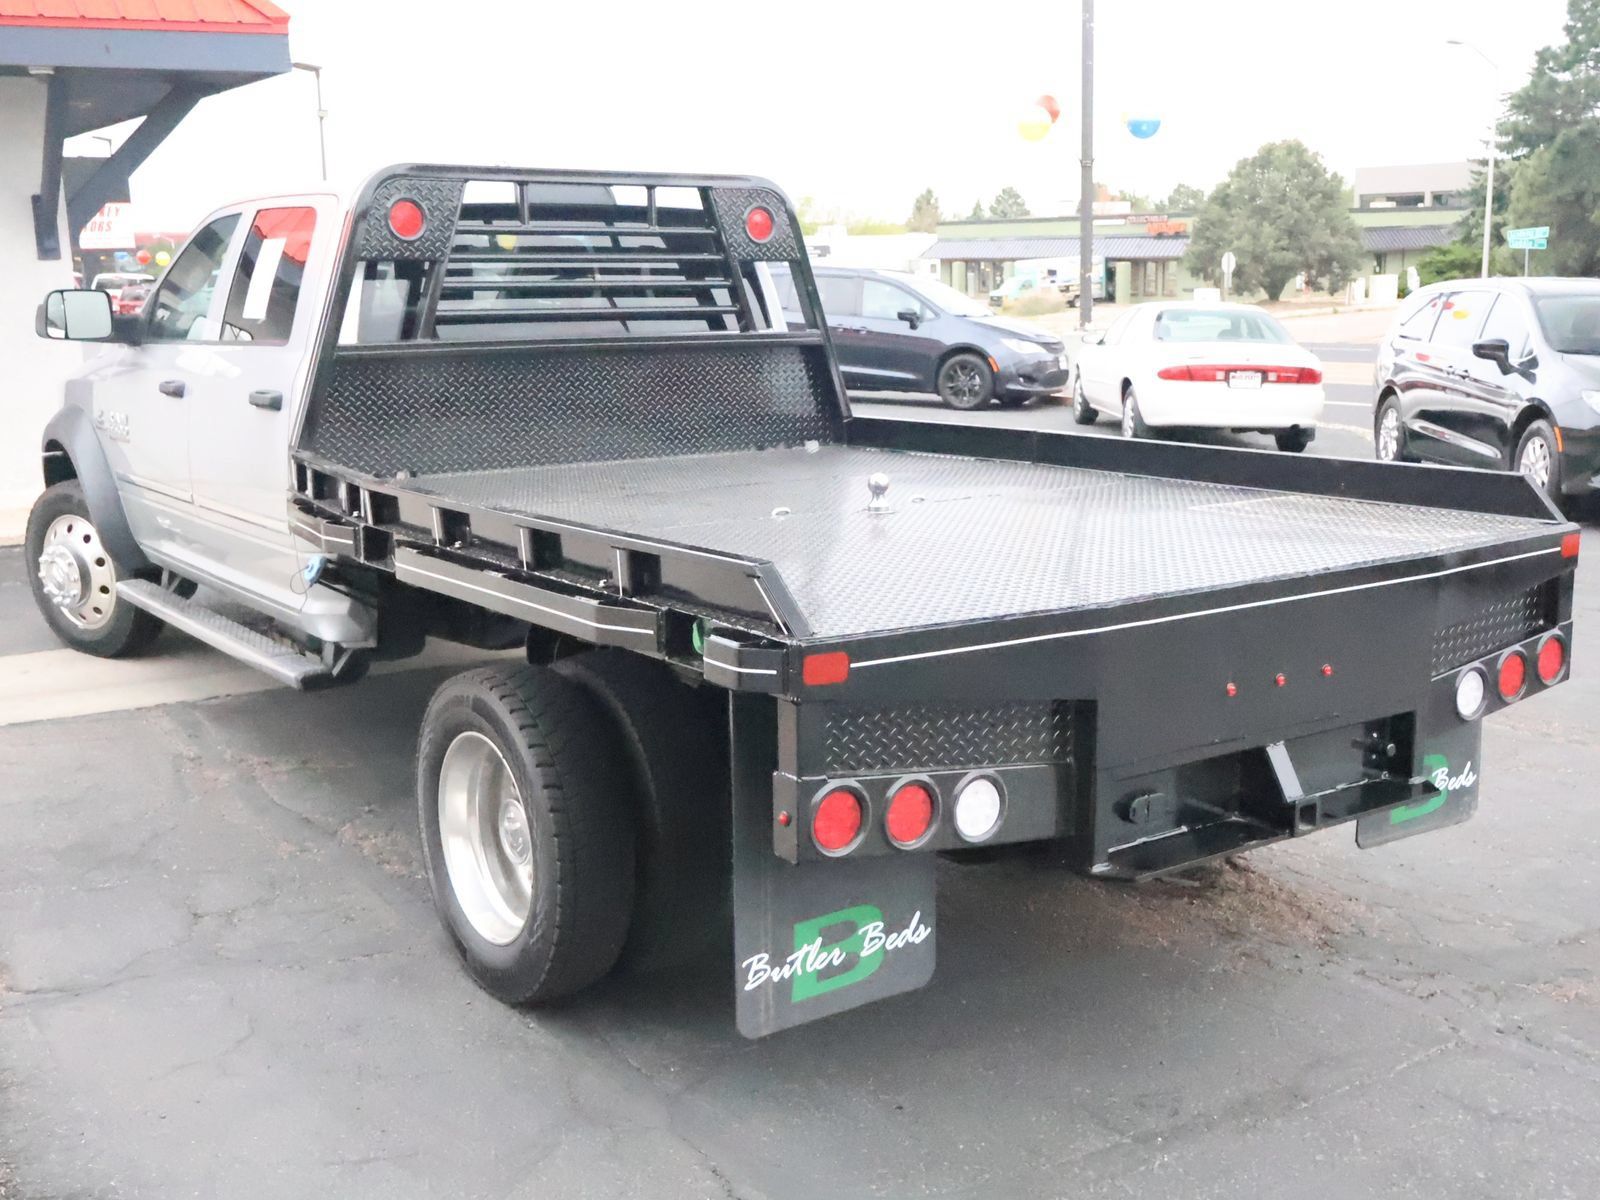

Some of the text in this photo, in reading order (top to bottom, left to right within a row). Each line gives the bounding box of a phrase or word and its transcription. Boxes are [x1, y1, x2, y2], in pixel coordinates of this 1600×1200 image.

[1431, 760, 1477, 791] Beds
[742, 910, 931, 991] Butler Beds
